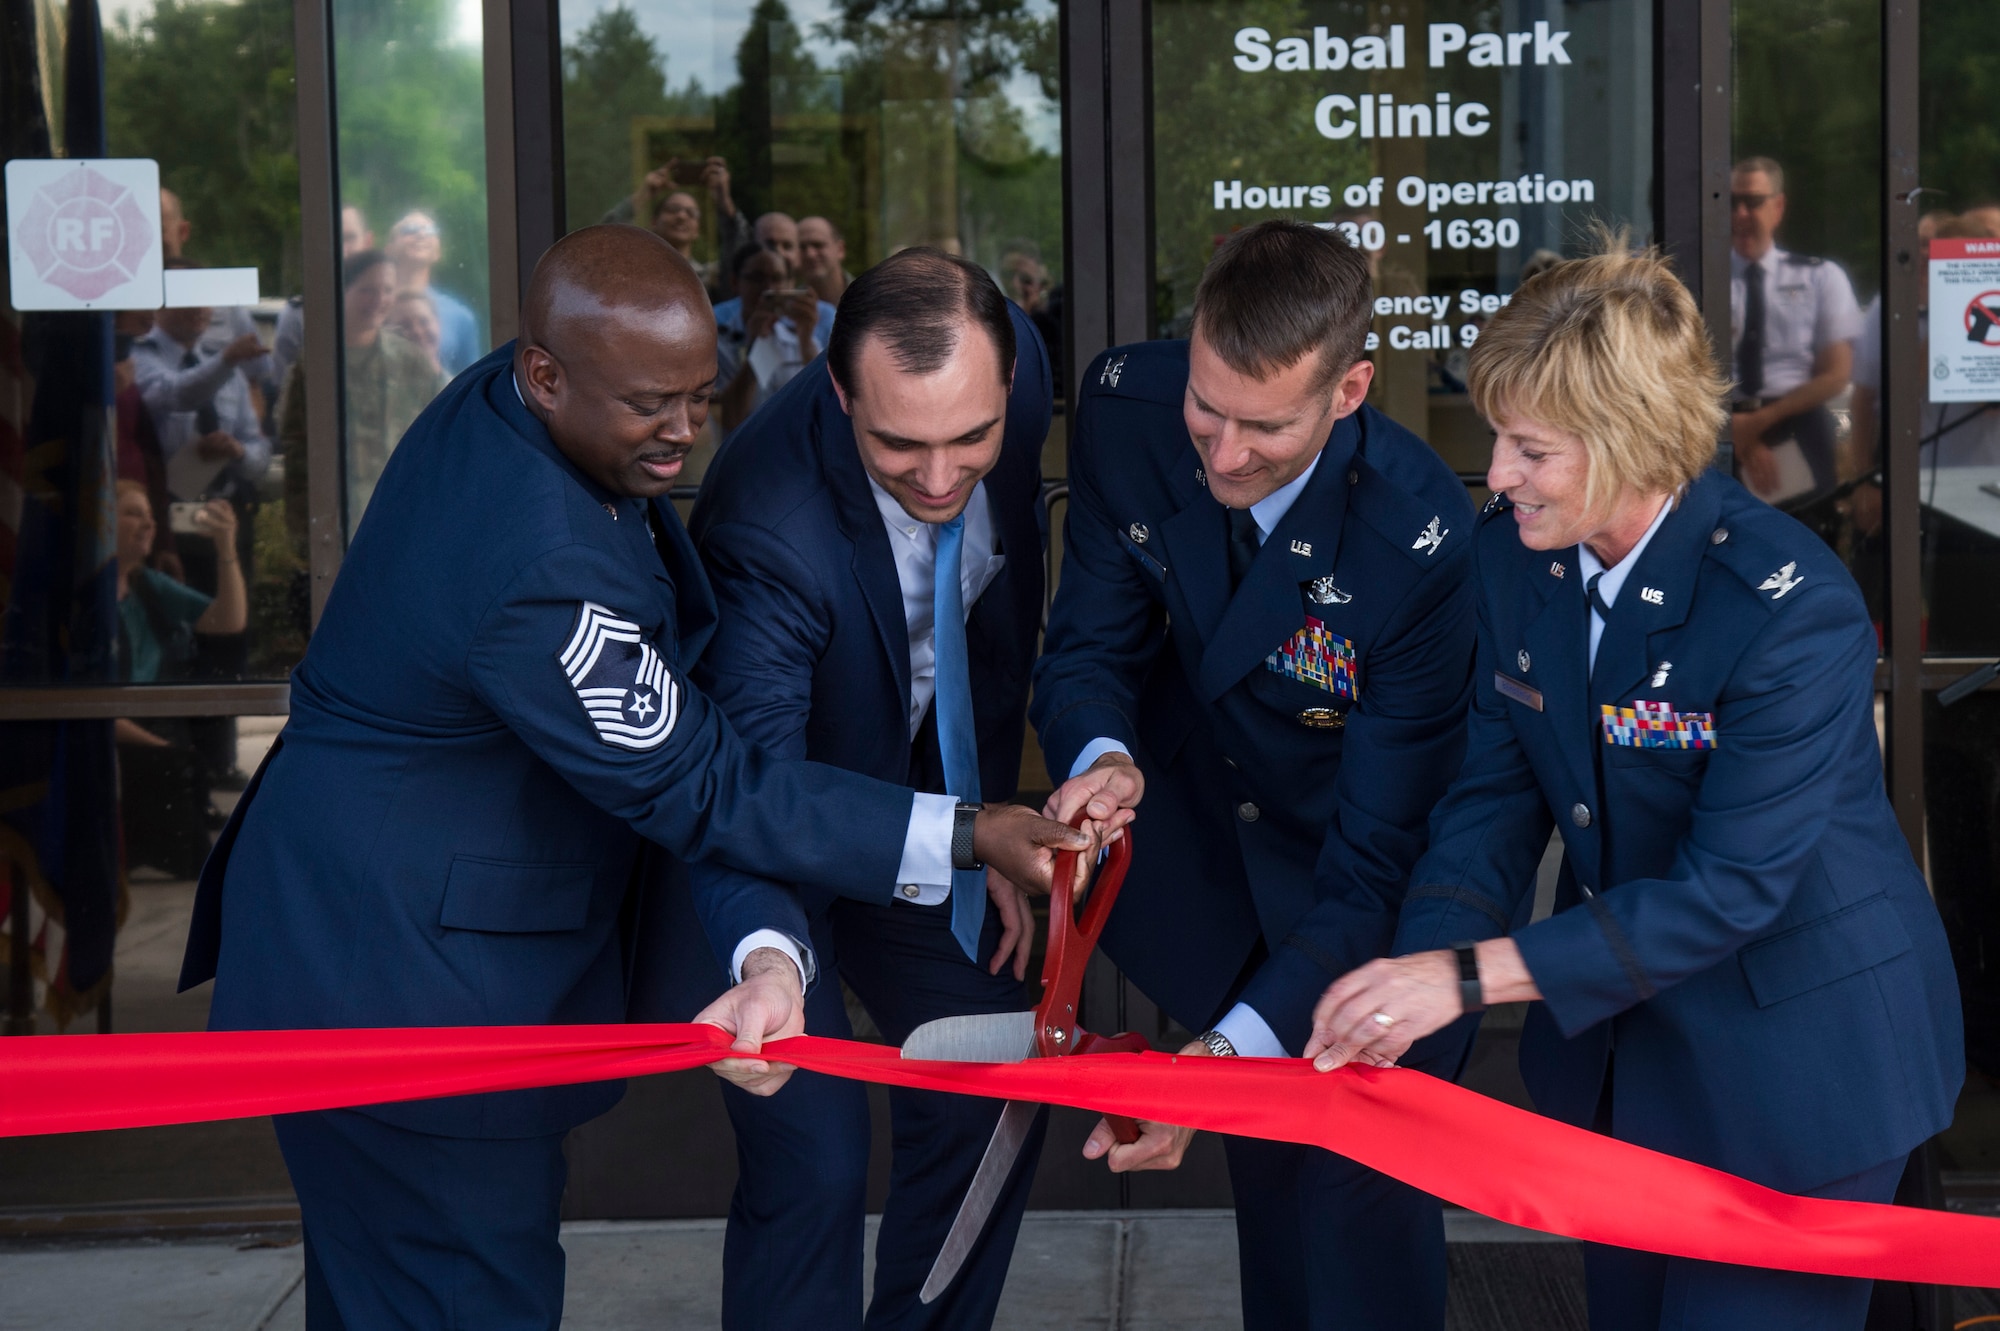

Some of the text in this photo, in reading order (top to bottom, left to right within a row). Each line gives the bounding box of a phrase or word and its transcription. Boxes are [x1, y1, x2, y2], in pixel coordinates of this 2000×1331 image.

[1233, 21, 1572, 72] Sabal Park
[1314, 93, 1491, 139] Clinic
[1213, 174, 1594, 212] Hours of Operation
[56, 217, 114, 251] RF
[1313, 221, 1385, 251] 30
[1423, 218, 1520, 249] 1630
[1459, 289, 1512, 314] Ser
[1389, 325, 1450, 350] Call
[1460, 324, 1480, 349] 9
